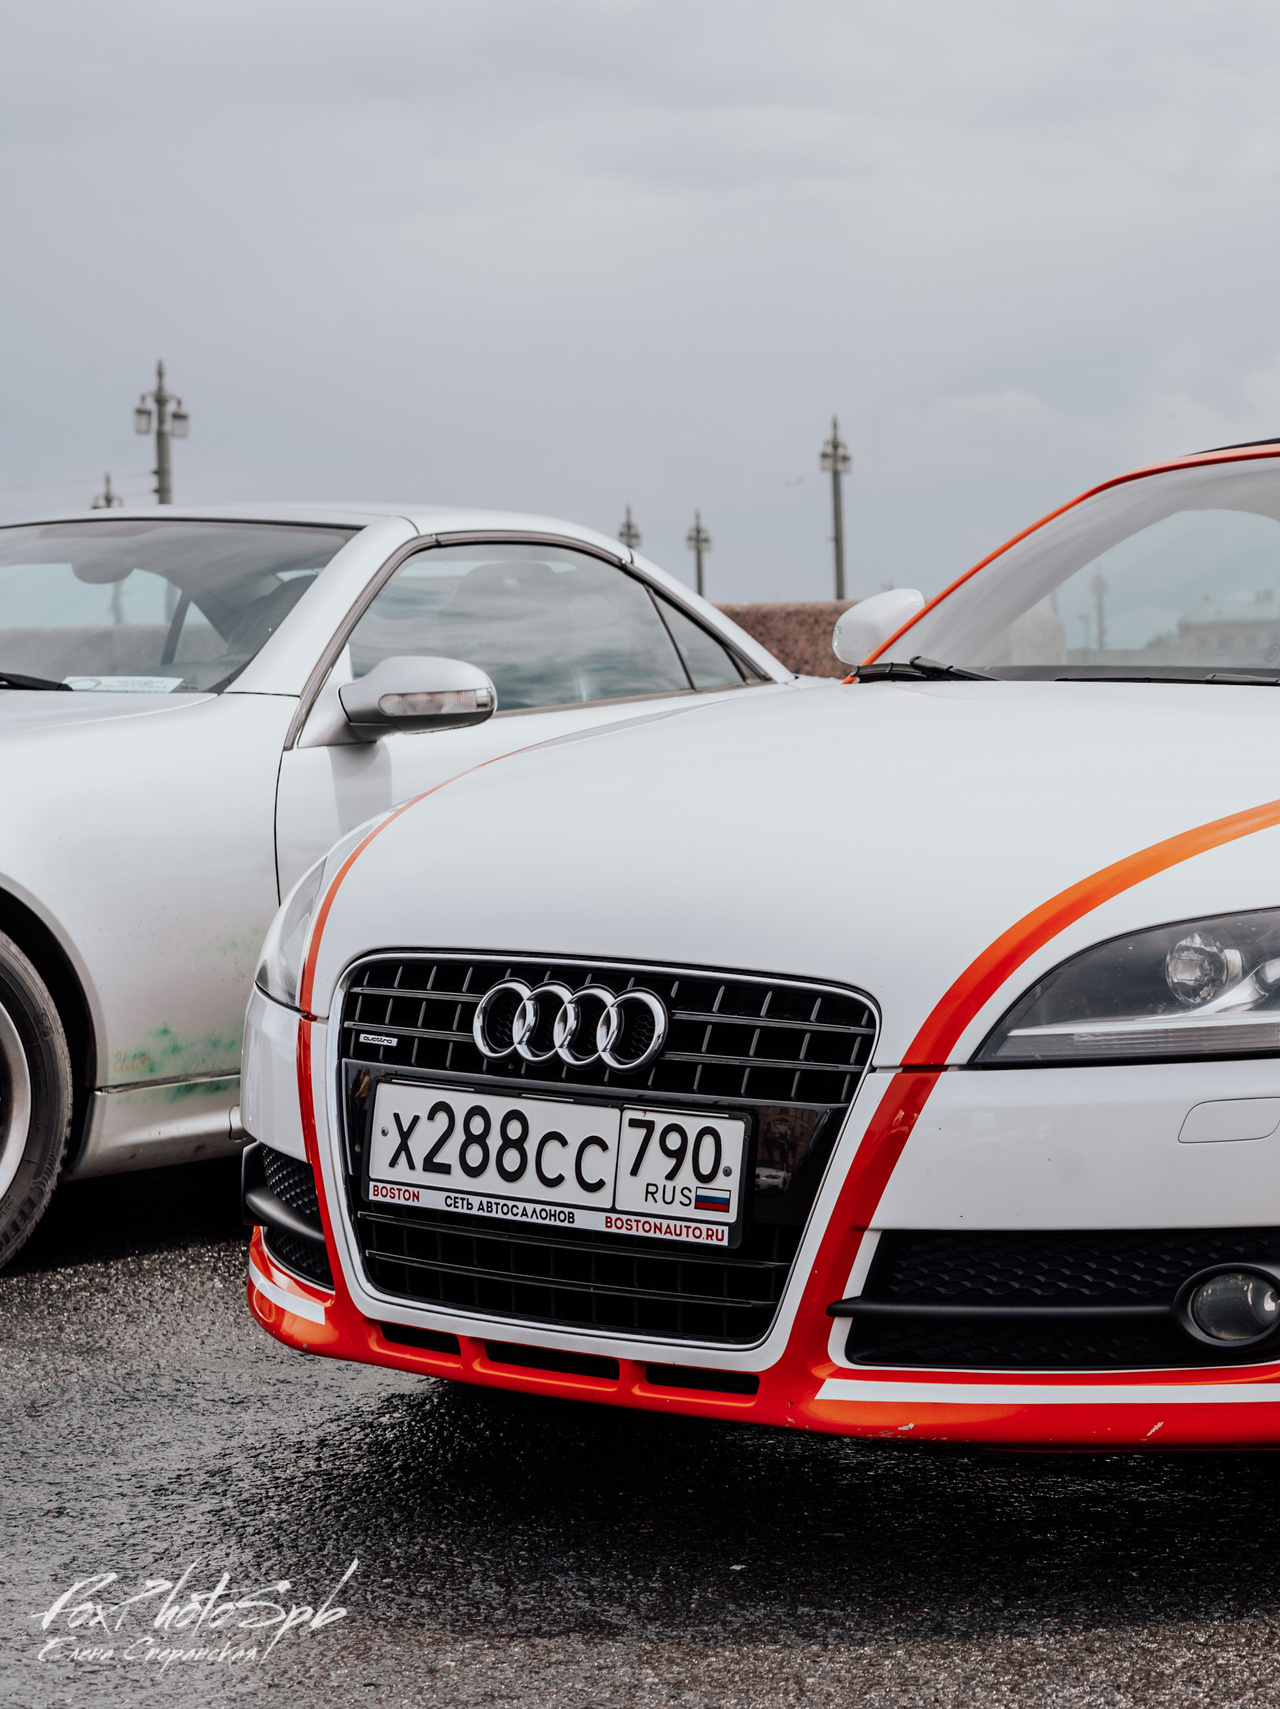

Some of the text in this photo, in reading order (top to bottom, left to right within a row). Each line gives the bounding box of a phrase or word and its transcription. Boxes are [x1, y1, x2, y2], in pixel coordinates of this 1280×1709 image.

[363, 1036, 393, 1044] quattro
[627, 1118, 722, 1184] 790
[372, 1184, 725, 1242] BOSTON СЕТЬ АВТОСАЛОНОВ BOSTONAUTO.RU
[645, 1183, 692, 1207] RUS
